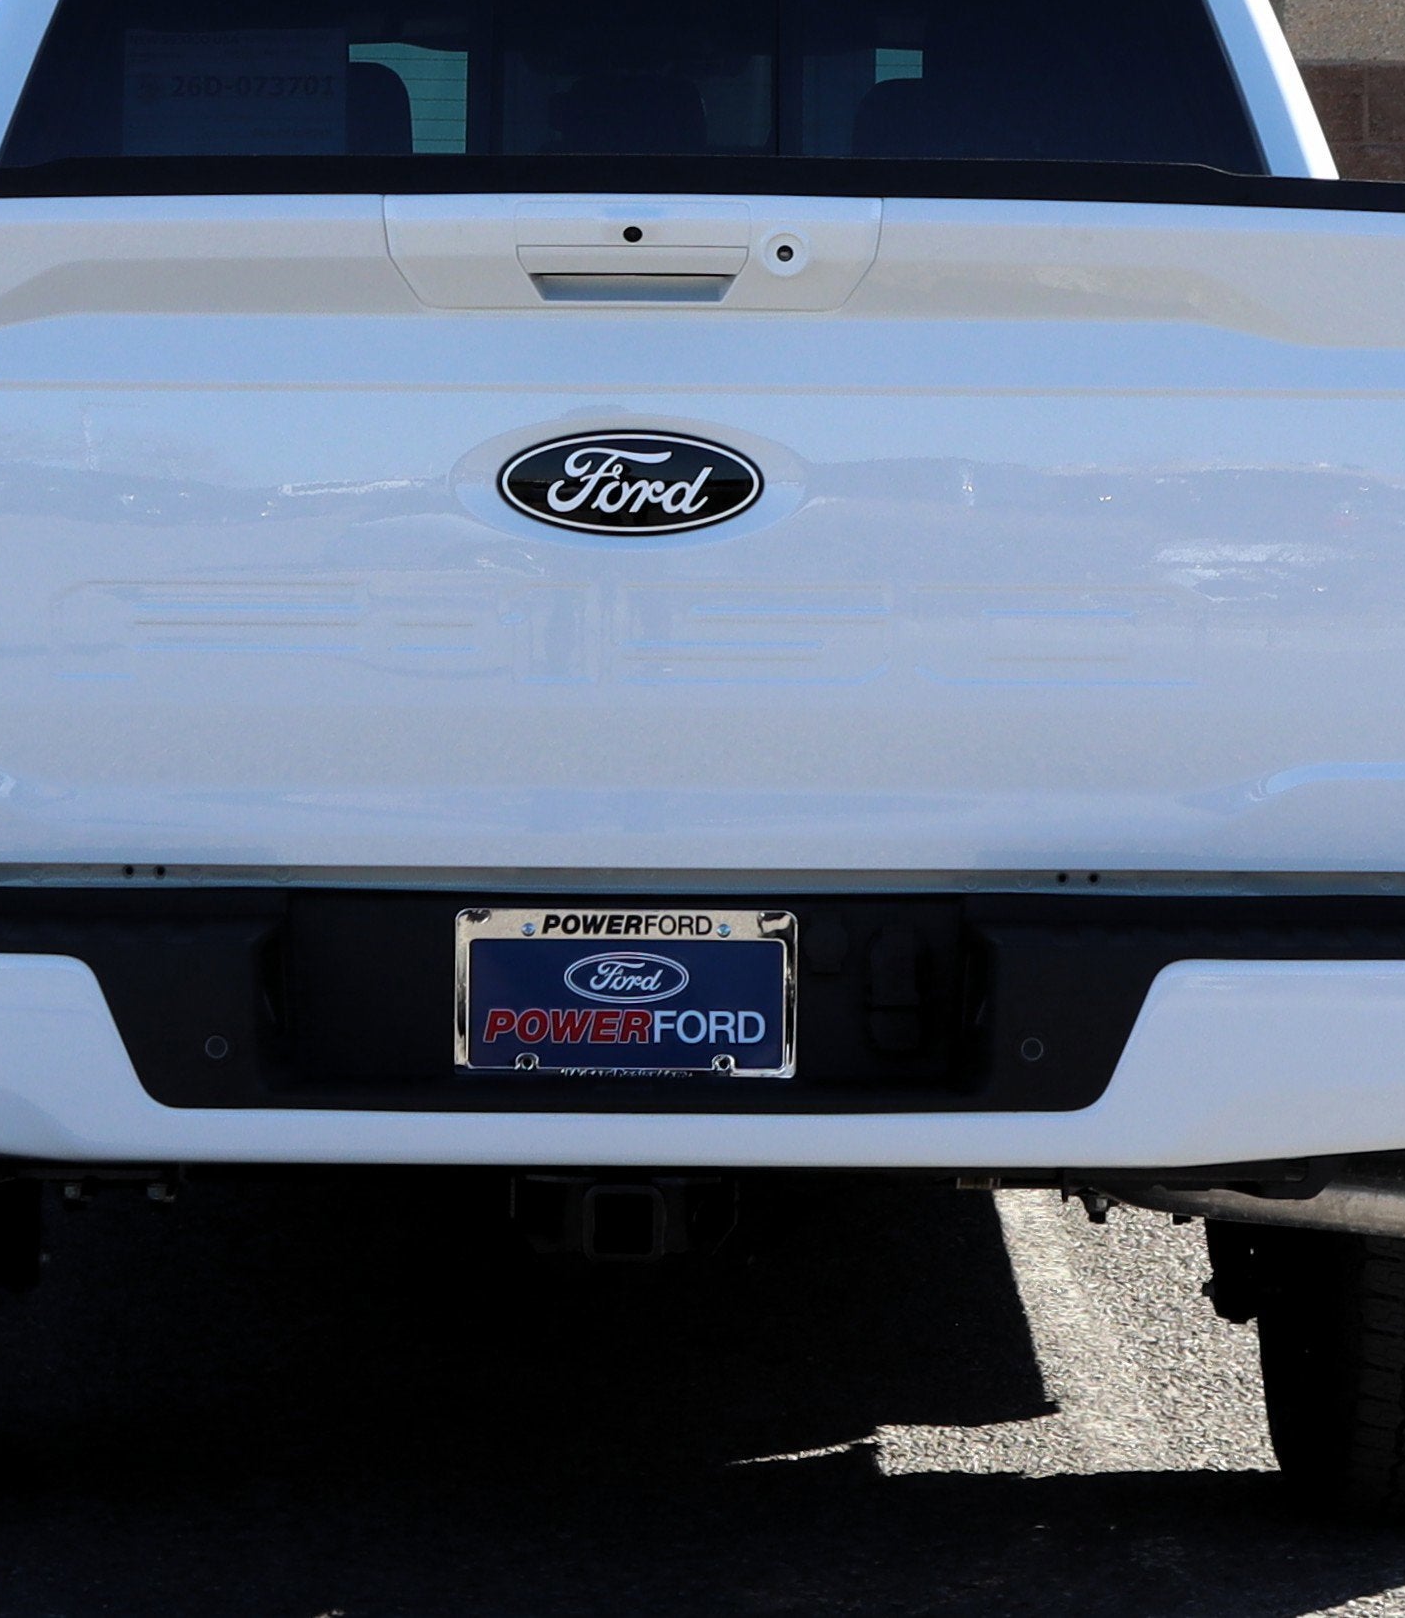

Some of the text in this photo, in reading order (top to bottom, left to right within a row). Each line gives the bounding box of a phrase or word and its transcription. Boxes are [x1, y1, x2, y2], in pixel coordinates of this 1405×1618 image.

[546, 446, 714, 515] Ford
[541, 914, 713, 936] POWERFORD
[589, 959, 663, 993] Ford
[483, 1007, 767, 1045] POWERFORD
